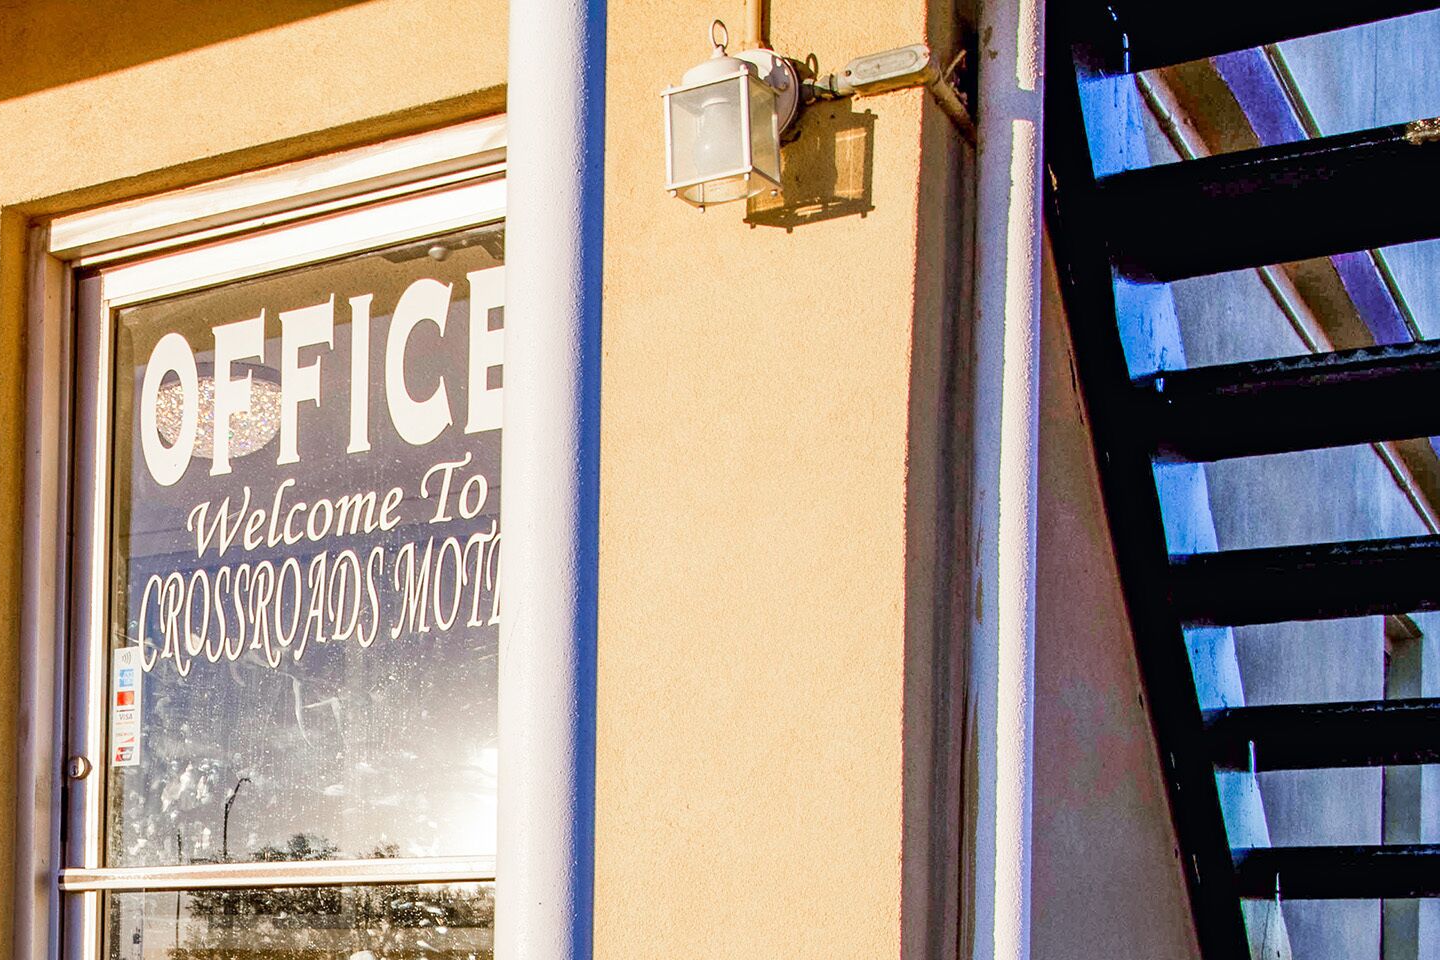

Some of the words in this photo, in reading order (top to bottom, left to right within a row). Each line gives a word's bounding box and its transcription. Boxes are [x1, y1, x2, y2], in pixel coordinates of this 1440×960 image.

[187, 478, 402, 558] Welcome
[420, 451, 488, 525] To
[137, 546, 385, 677] CROSSROADS
[119, 712, 133, 721] VISA
